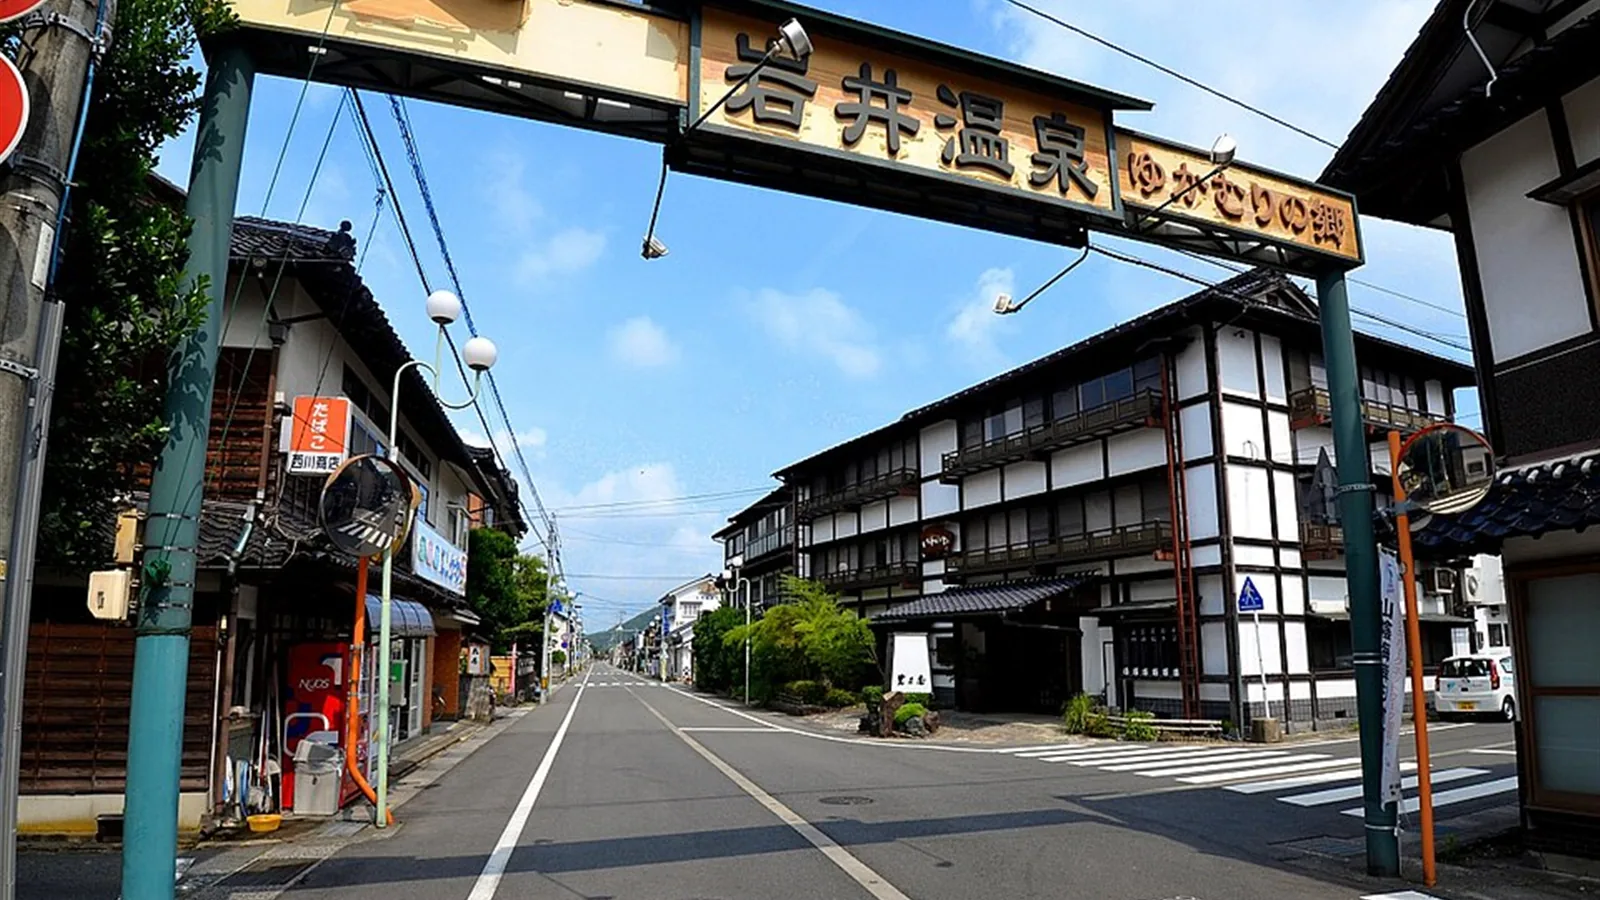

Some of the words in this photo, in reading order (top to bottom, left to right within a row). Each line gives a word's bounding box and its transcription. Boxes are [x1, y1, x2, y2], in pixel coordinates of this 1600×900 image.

[724, 31, 1100, 198] 岩井温泉
[1128, 151, 1346, 251] ゆかむりの郷
[291, 453, 341, 471] 西川商店
[310, 402, 329, 451] たばこ
